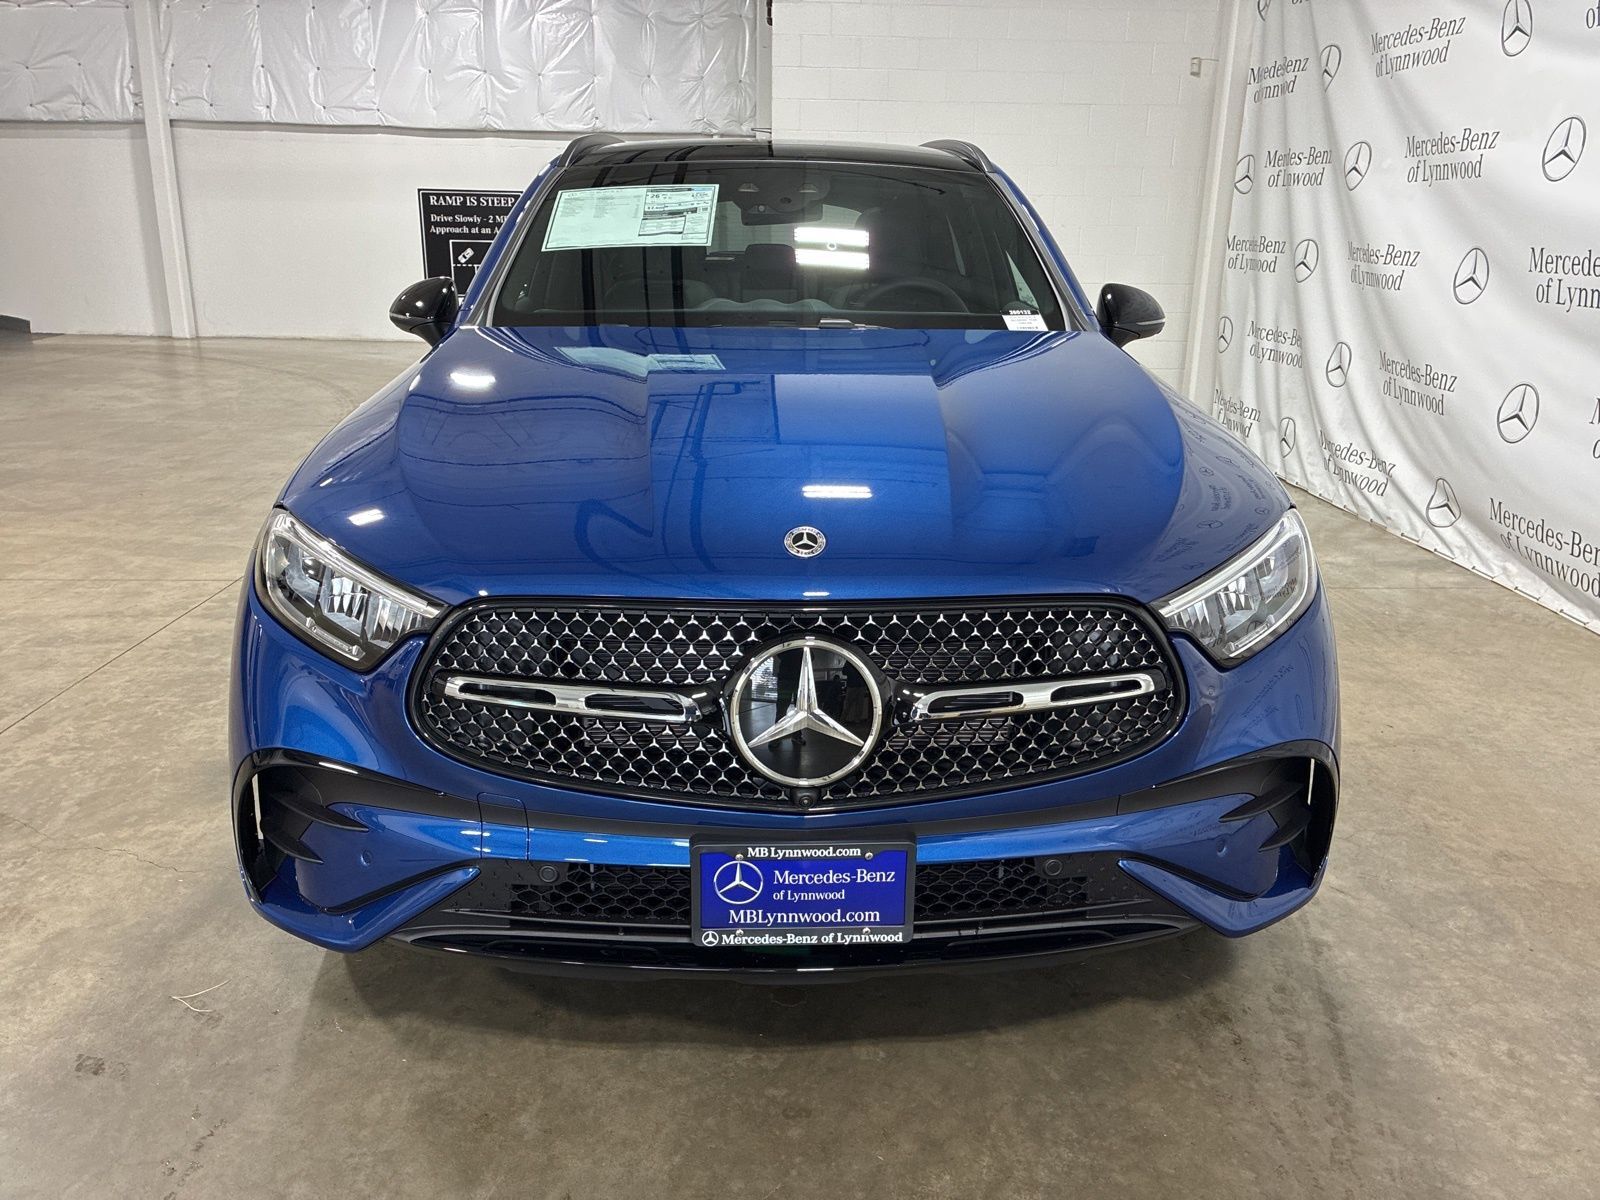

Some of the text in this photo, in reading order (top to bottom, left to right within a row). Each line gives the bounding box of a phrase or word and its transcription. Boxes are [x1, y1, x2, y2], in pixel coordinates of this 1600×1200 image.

[1370, 17, 1466, 55] Mercedes-Benz
[1375, 39, 1450, 79] of Lynnwood
[1404, 127, 1500, 158] Mercedes-Benz
[1268, 169, 1282, 187] of
[1407, 153, 1483, 187] of Lynnwood
[429, 195, 515, 207] RAMP IS STEEP
[430, 214, 453, 222] Drive
[455, 214, 481, 225] Slowly
[488, 215, 494, 223] 2
[430, 225, 469, 235] Approach
[471, 226, 479, 234] at
[1228, 254, 1240, 269] of
[1536, 278, 1553, 304] of
[1379, 350, 1458, 393] Mercedes-Benz
[1383, 376, 1445, 416] of Lynnwood
[773, 869, 896, 885] Mercedes-Benz
[773, 889, 845, 903] of Lynnwood
[728, 908, 881, 927] MBLynnwood.com
[721, 931, 904, 946] Mercedes-Benz of Lynnwood
